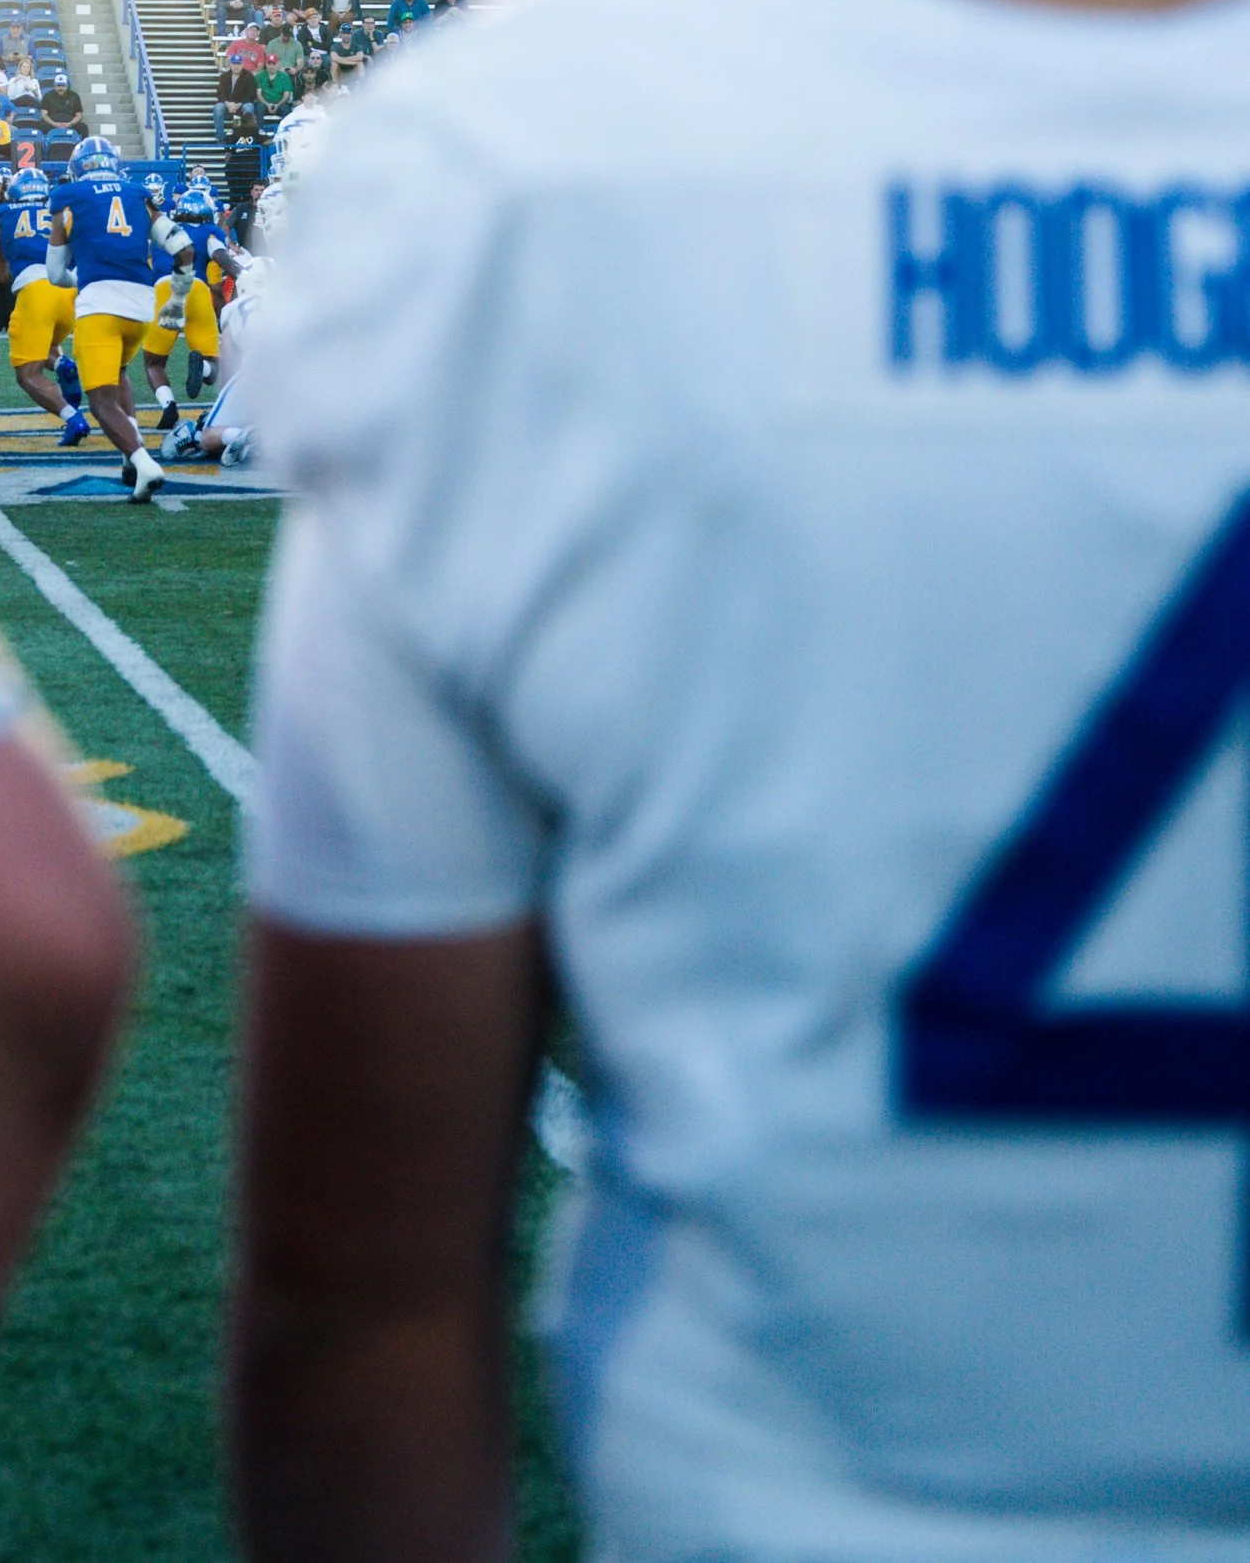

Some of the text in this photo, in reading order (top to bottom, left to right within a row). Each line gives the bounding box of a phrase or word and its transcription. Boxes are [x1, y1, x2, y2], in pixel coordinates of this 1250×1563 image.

[16, 141, 36, 169] 2
[93, 182, 122, 195] LATU
[13, 209, 53, 239] 45
[106, 195, 133, 237] 4
